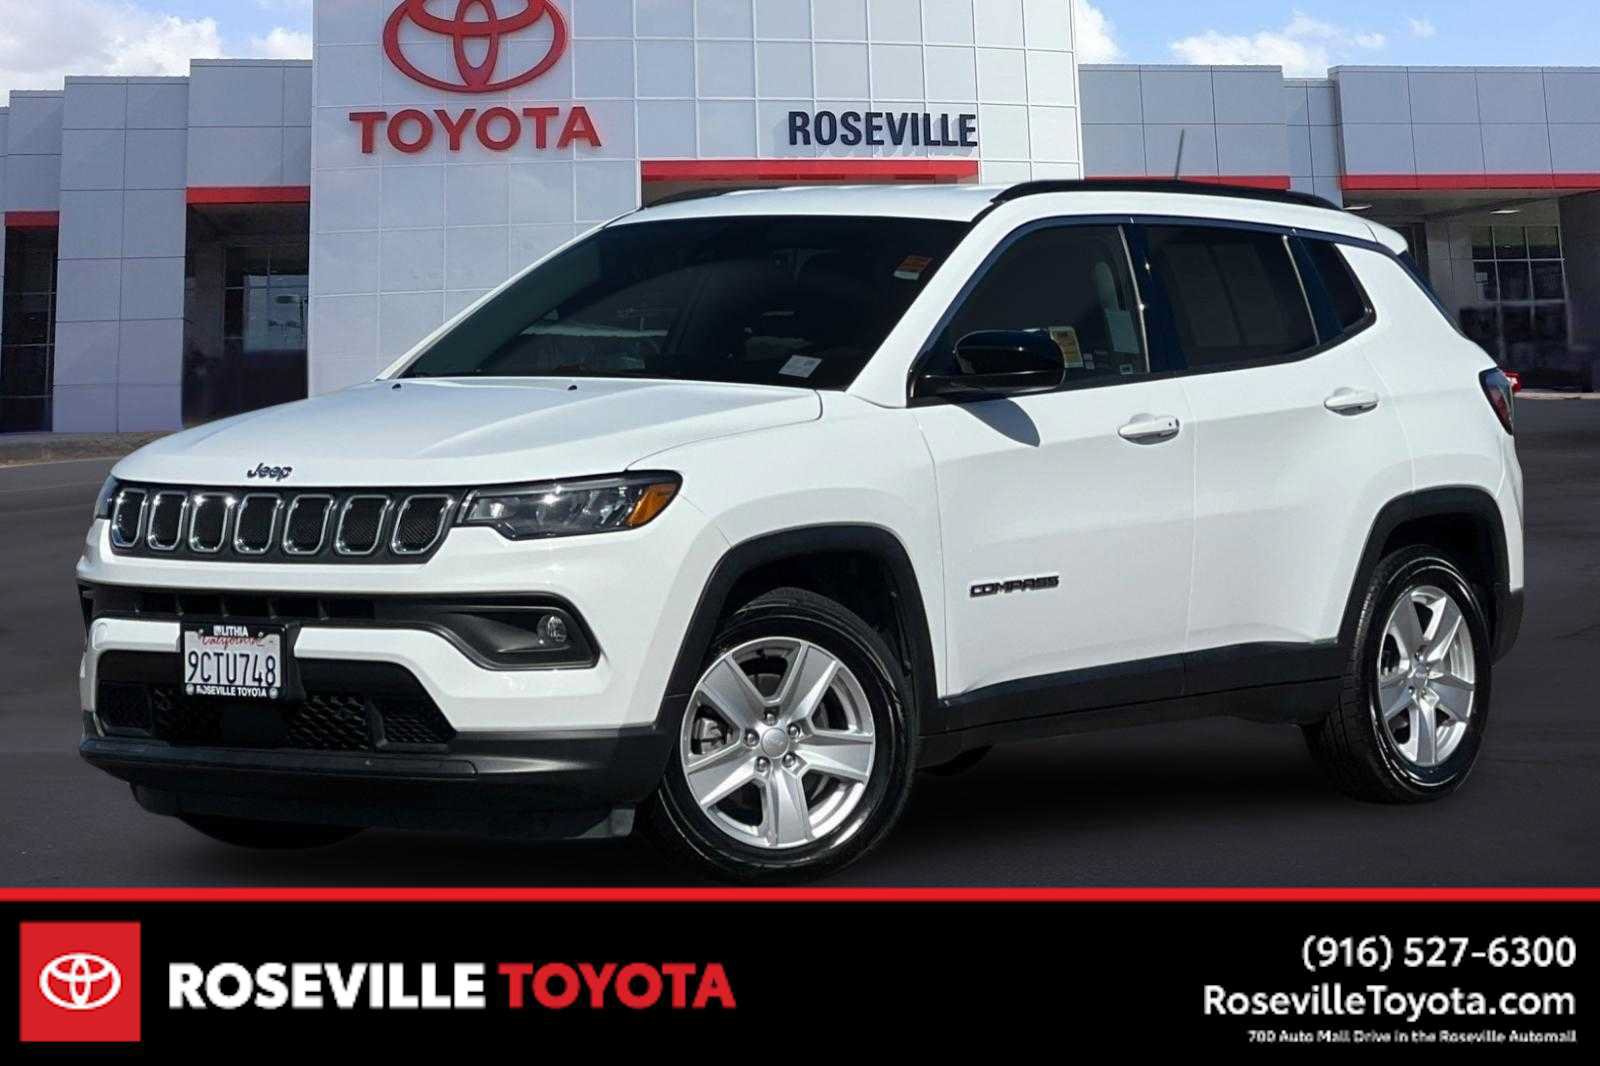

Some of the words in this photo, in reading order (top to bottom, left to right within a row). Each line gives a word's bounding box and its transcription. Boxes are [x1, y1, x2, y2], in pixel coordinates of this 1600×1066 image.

[349, 106, 602, 154] TOYOTA
[788, 110, 978, 147] ROSEVILLE
[246, 462, 293, 482] Jeep
[969, 575, 1059, 597] COMPASS
[221, 625, 249, 636] LITHIA
[188, 650, 276, 687] 9CTU748
[196, 684, 236, 697] ROSEVILLE
[237, 687, 267, 697] TOYOTA
